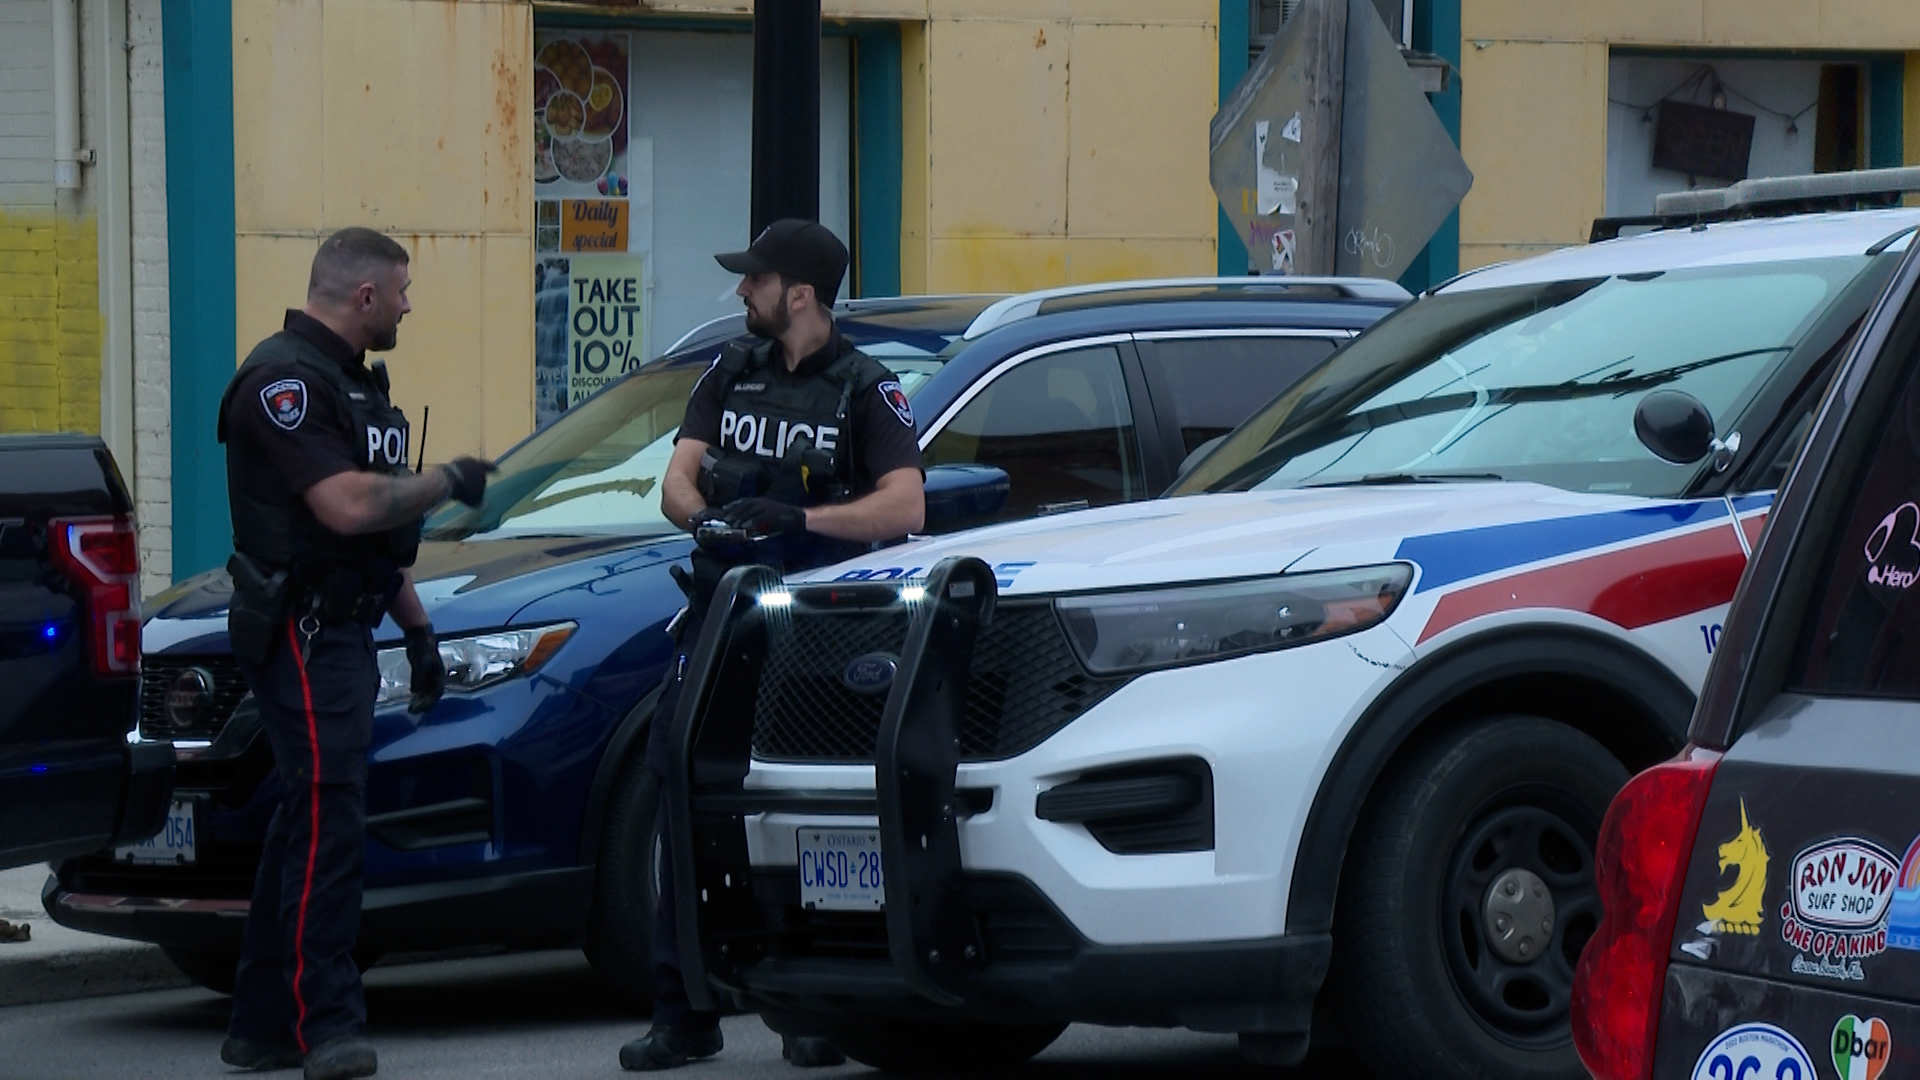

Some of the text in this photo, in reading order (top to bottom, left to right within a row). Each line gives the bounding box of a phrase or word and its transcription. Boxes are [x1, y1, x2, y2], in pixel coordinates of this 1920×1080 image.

[573, 201, 618, 227] Daily
[572, 232, 616, 252] special
[574, 278, 636, 304] TAKE
[573, 305, 640, 337] OUT
[574, 340, 640, 374] 10%
[572, 377, 621, 388] DISCOUN
[853, 663, 882, 682] Ford
[167, 816, 193, 848] 054
[802, 851, 848, 888] CWSD
[1801, 853, 1893, 896] RON JON
[1808, 892, 1874, 915] SURF SHOP
[1813, 932, 1835, 956] OF
[1835, 935, 1847, 957] A
[1834, 1029, 1887, 1060] Dbar
